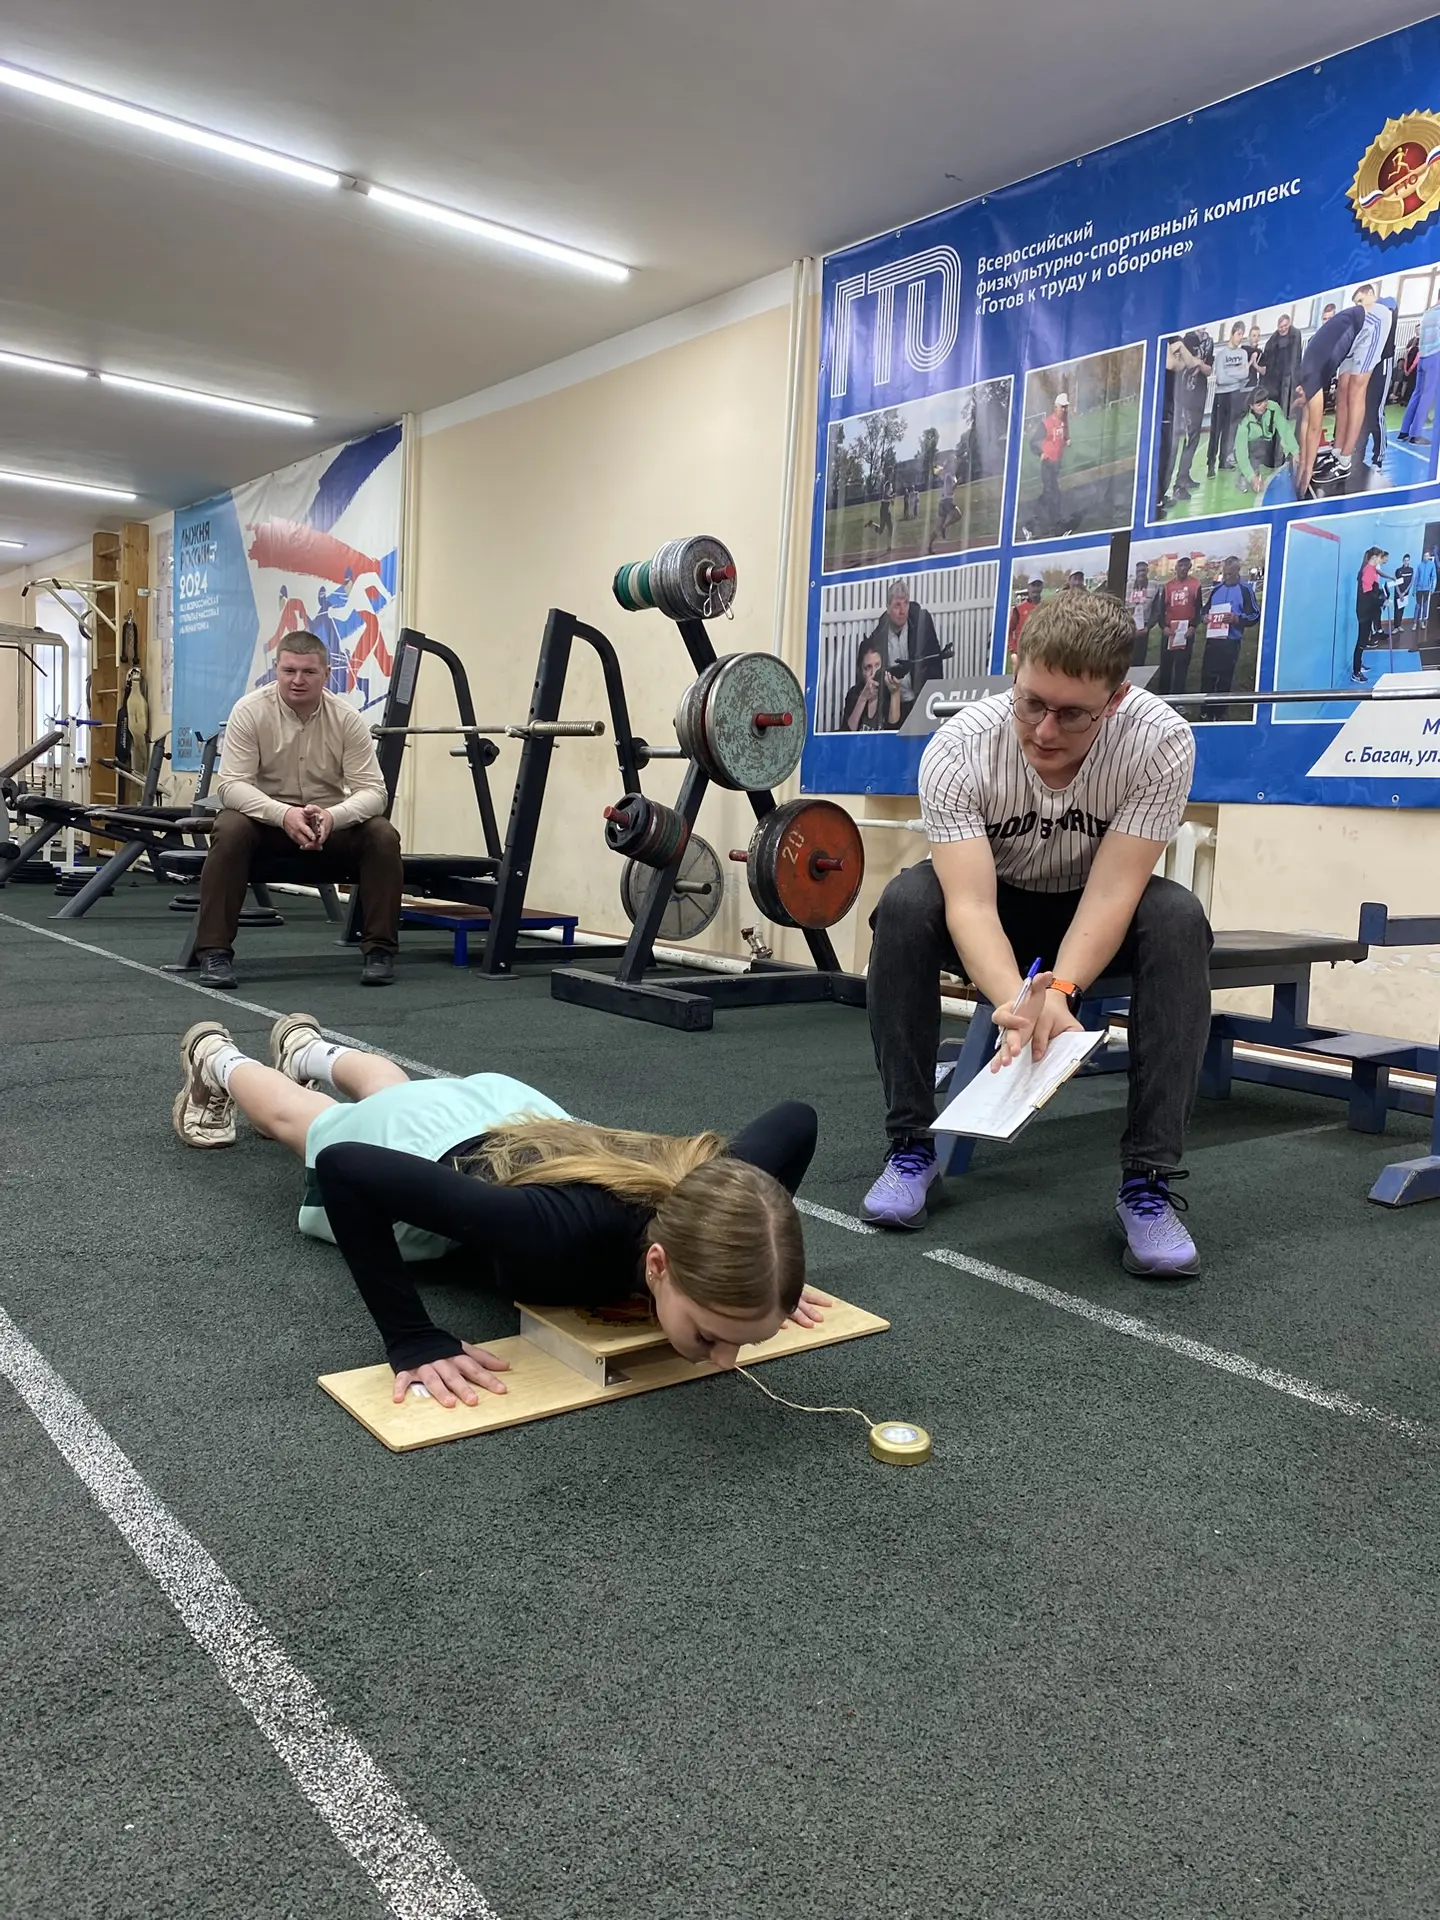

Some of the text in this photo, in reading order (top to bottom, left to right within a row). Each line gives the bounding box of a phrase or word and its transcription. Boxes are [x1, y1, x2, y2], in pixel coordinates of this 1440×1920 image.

[1393, 174, 1419, 195] ГТО
[976, 176, 1301, 299] физкультурно-спортивный комплекс
[977, 220, 1093, 275] Всероссийский
[975, 238, 1194, 317] «Готов к труду и обороне»
[831, 245, 962, 398] ГТО
[179, 569, 208, 600] 2024
[1344, 750, 1356, 763] с.
[1360, 746, 1413, 766] Баган,
[782, 831, 804, 864] 20
